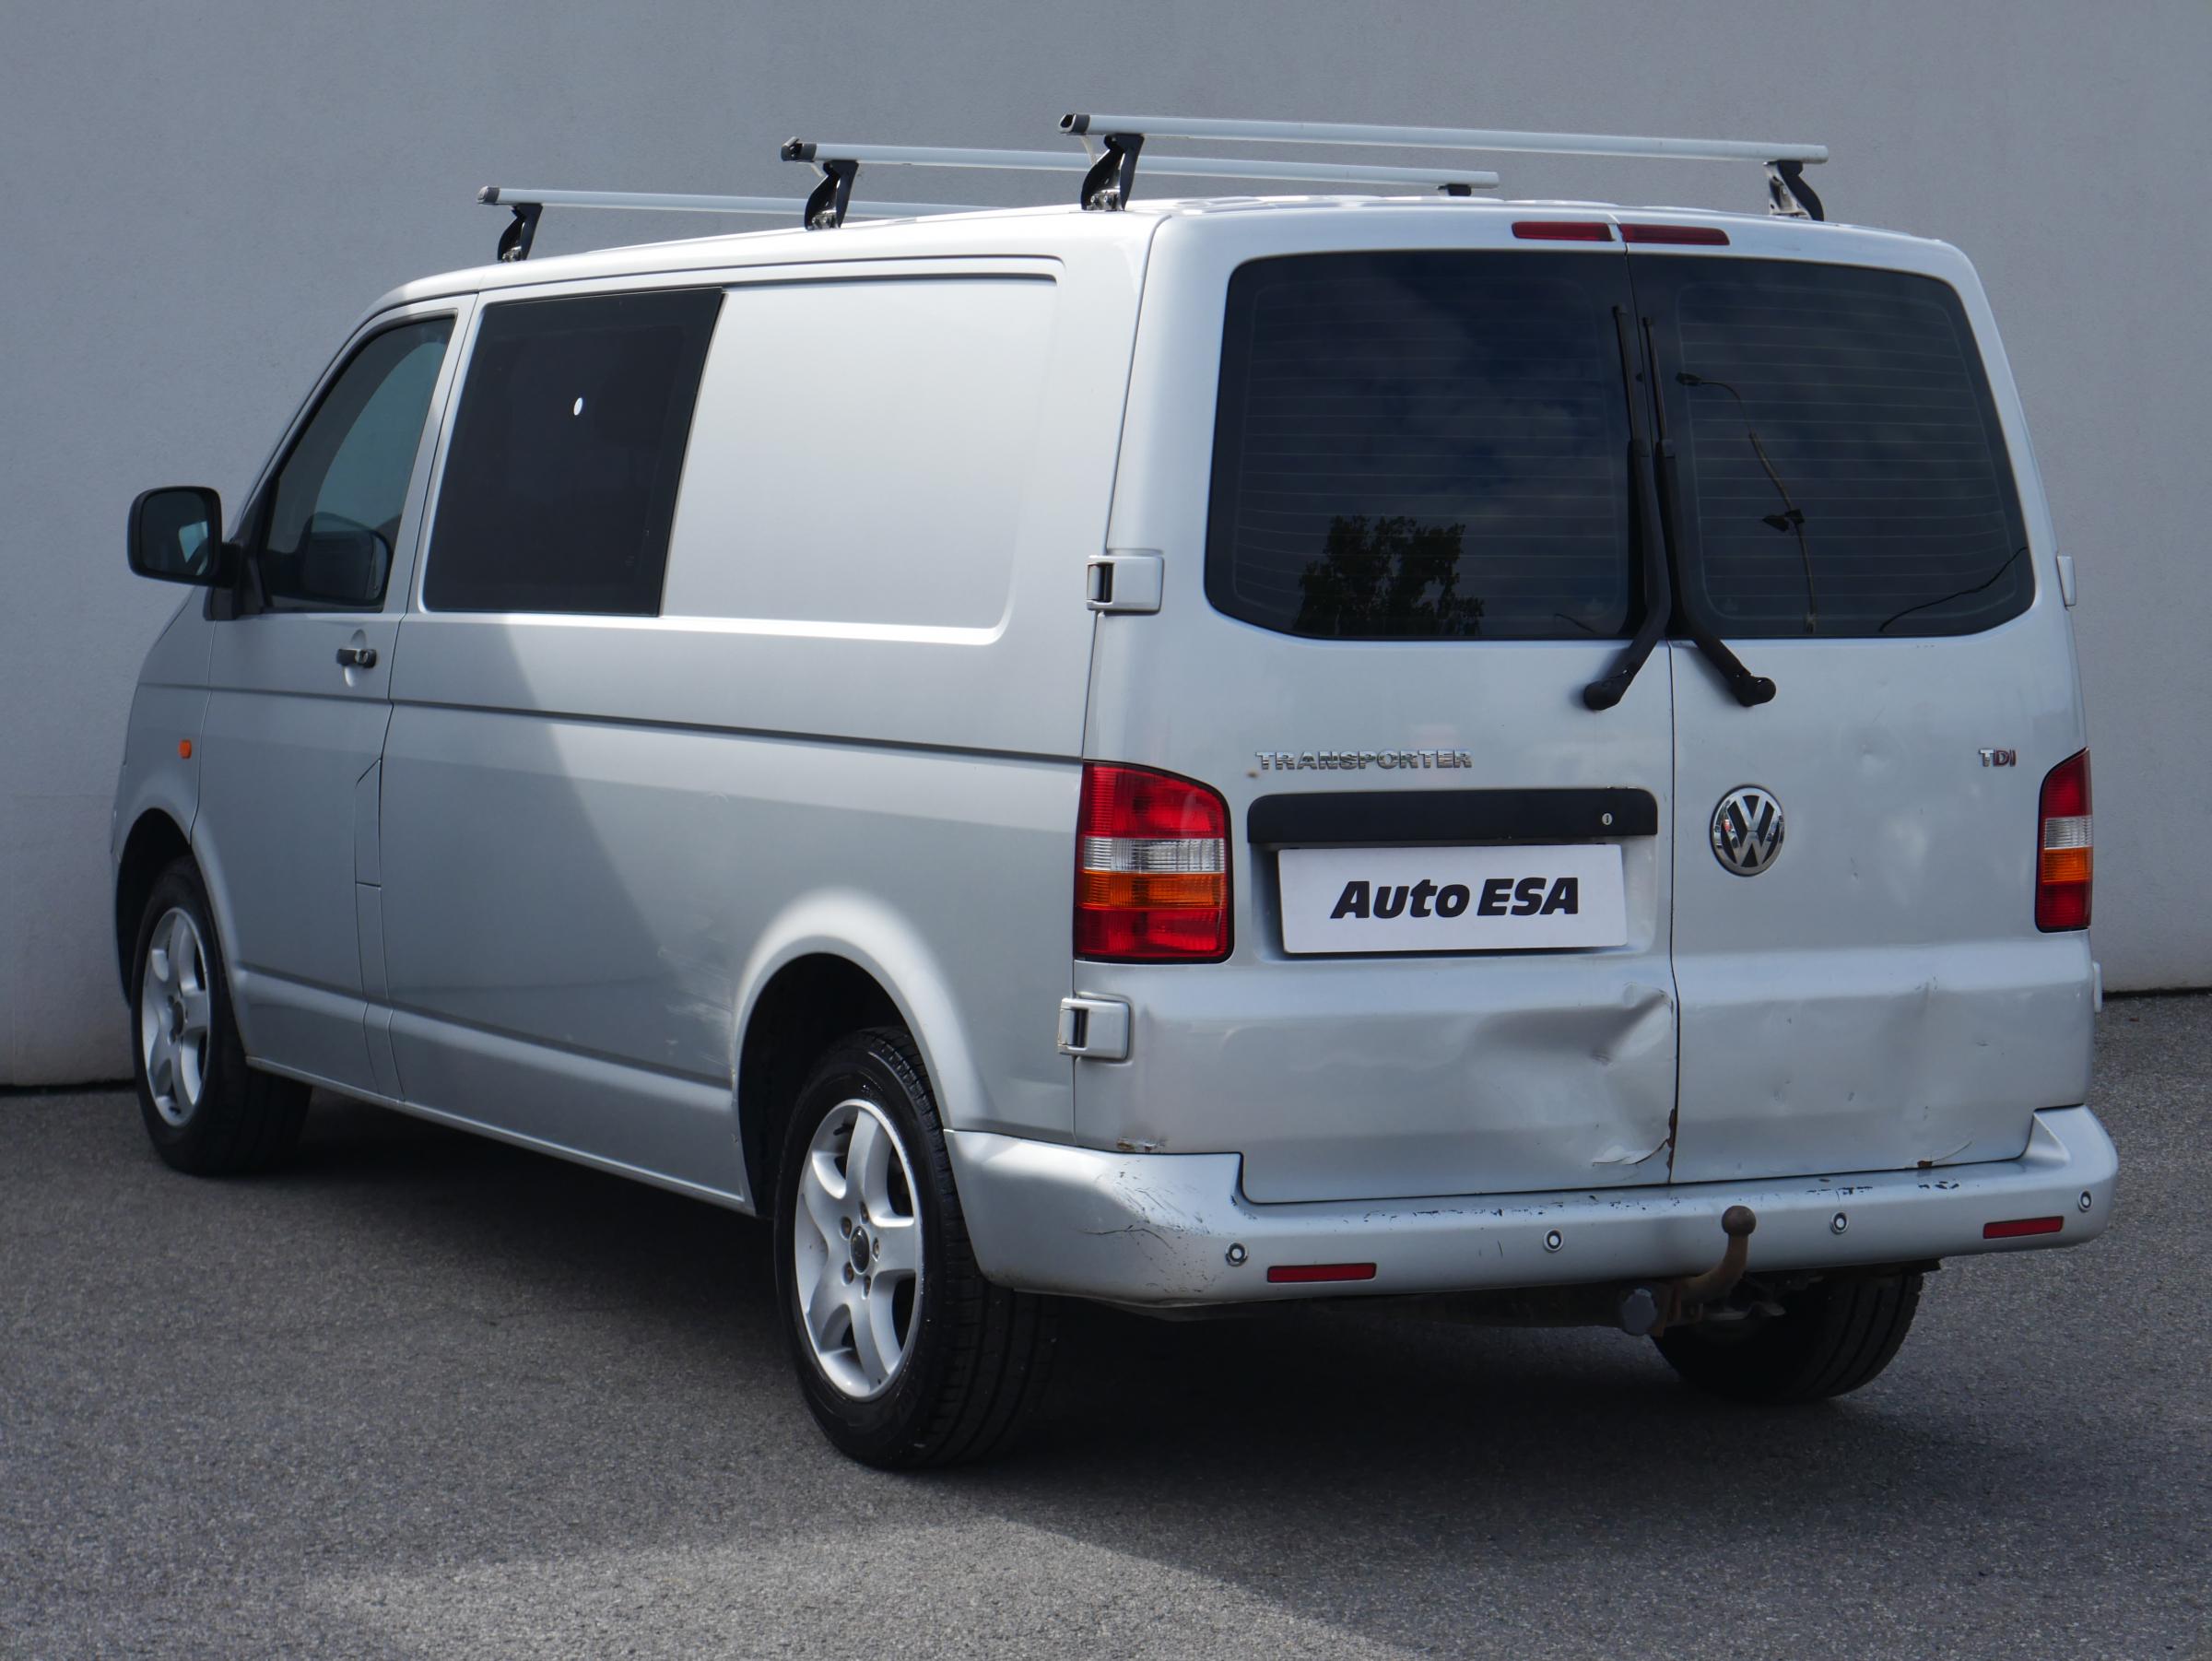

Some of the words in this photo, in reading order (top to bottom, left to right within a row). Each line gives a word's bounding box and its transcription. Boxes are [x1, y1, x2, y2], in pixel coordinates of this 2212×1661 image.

[1255, 749, 1473, 771] TRANSPORTER
[1978, 748, 2017, 767] TDI
[1330, 878, 1470, 919] Auto
[1477, 877, 1579, 916] ESA
